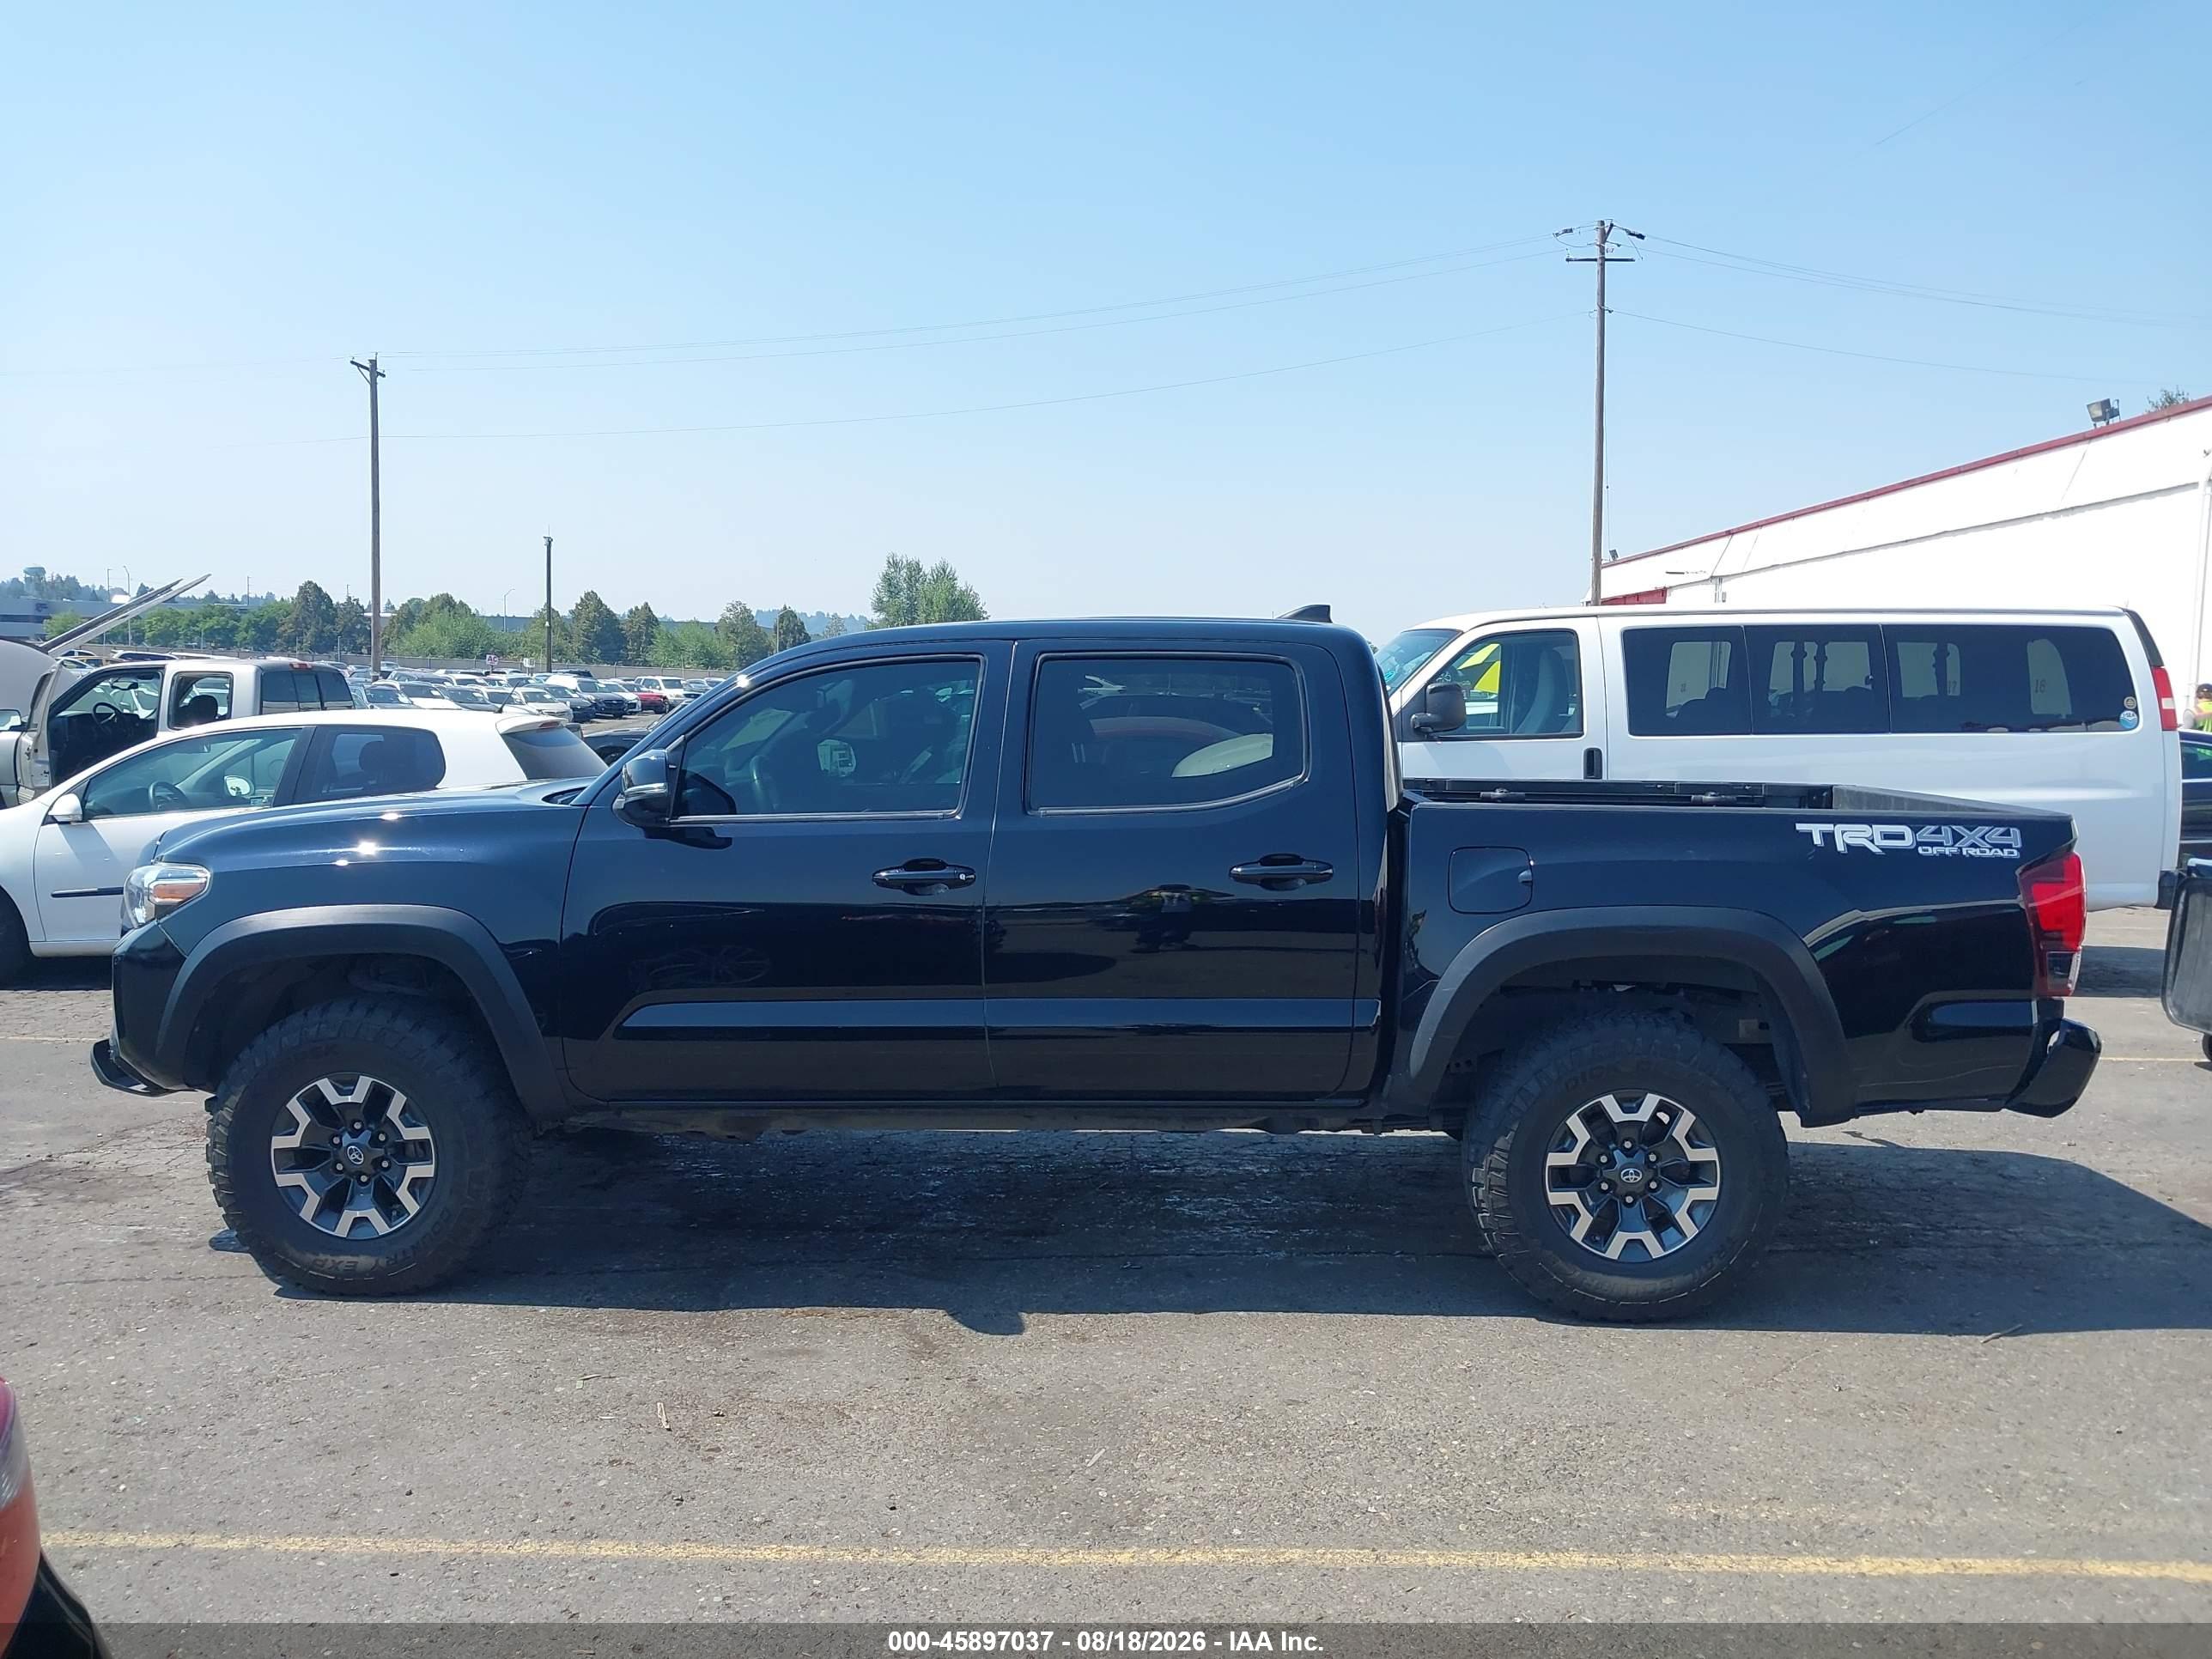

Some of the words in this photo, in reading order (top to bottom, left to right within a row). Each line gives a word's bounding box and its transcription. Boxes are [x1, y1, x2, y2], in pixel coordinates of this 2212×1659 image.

[1795, 823, 1916, 854] TRD
[1917, 846, 1960, 857] OFF
[1962, 847, 2021, 859] ROAD
